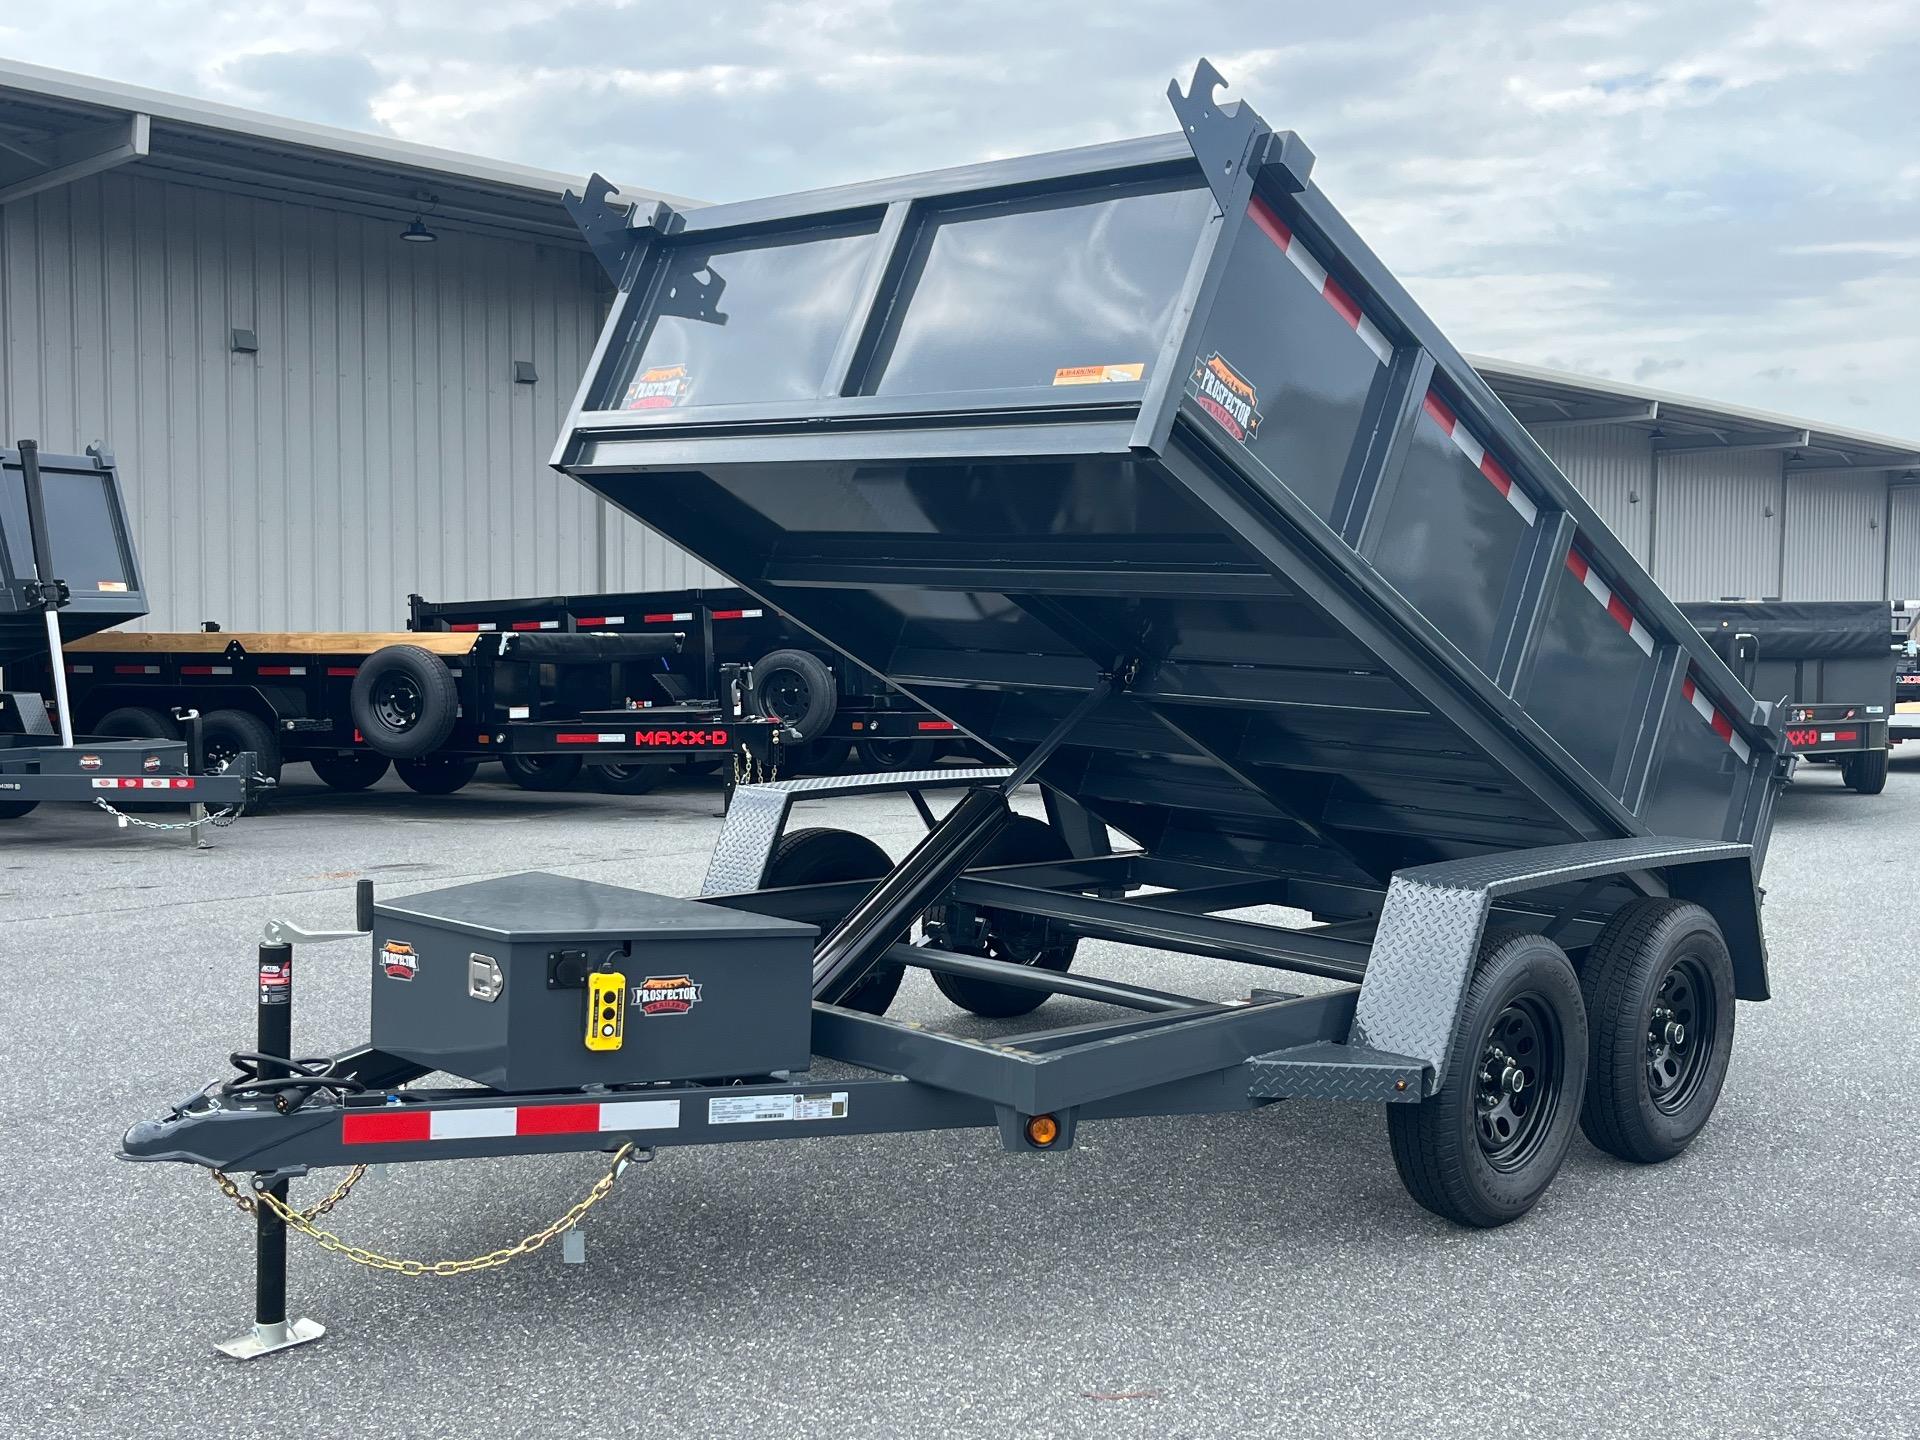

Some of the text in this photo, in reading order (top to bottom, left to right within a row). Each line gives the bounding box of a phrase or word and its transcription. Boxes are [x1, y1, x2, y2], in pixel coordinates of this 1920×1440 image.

[1200, 367, 1251, 429] PROSPECTOR
[635, 730, 727, 746] MAXX-D
[636, 986, 697, 1004] PROSPECTOR
